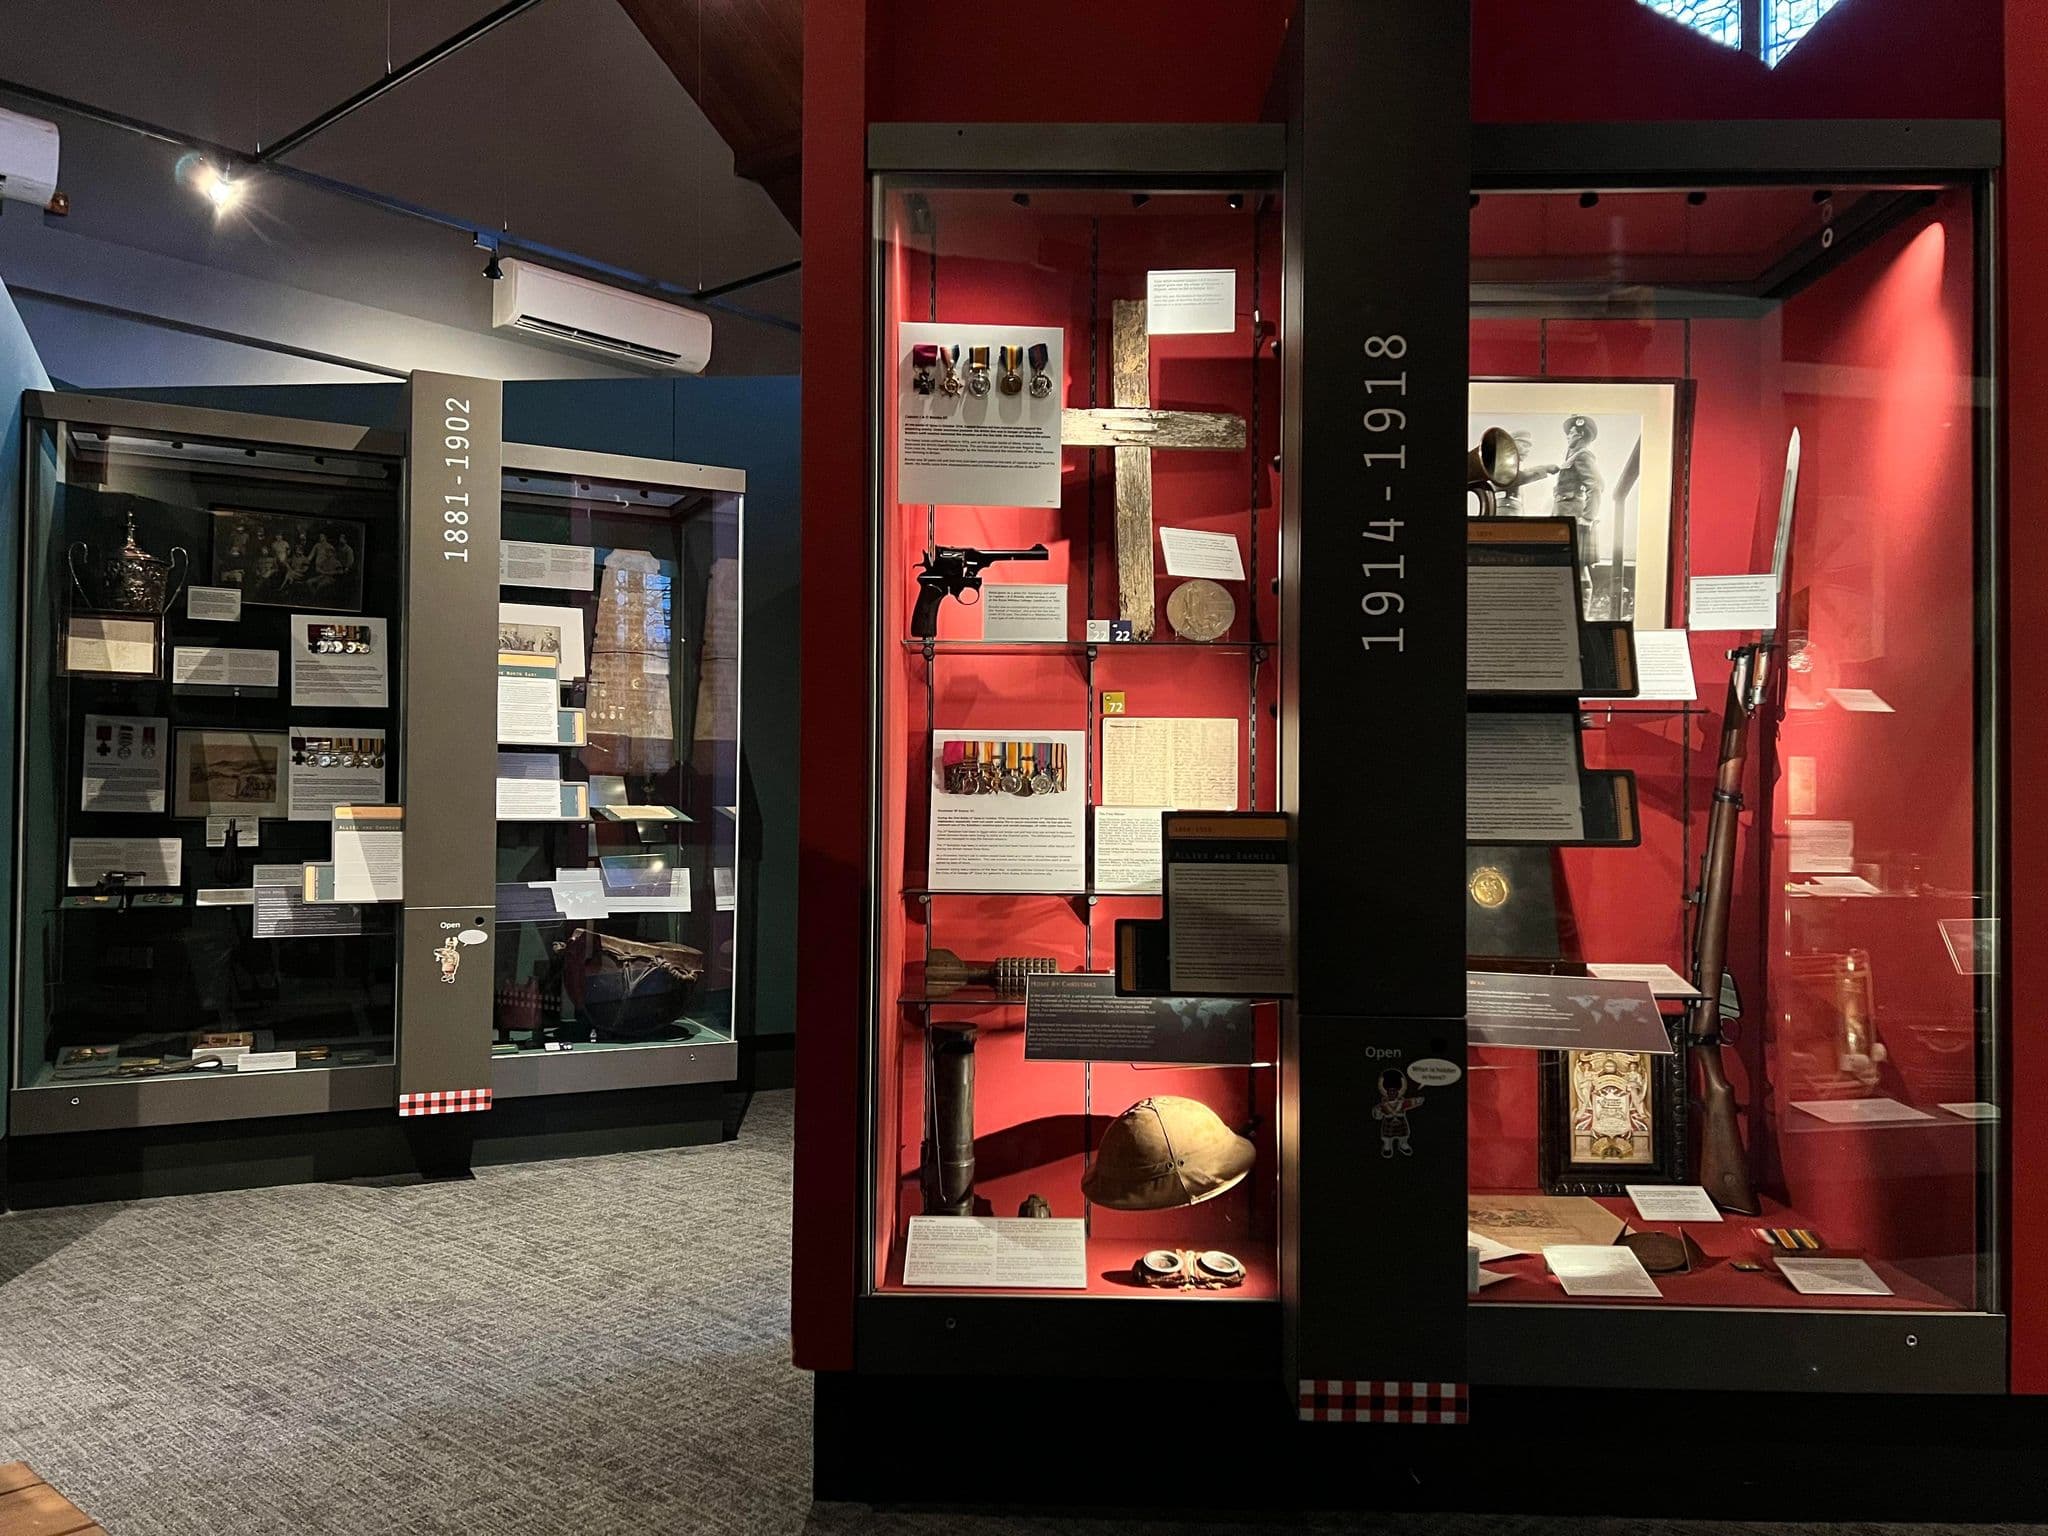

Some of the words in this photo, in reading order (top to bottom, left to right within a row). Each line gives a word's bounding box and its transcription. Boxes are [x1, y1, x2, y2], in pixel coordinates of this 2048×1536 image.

[444, 398, 470, 563] 1881-1902
[1361, 334, 1407, 653] 1914-1918
[1115, 630, 1130, 642] 22
[1109, 703, 1123, 713] 72
[440, 921, 461, 929] Open
[1365, 1046, 1402, 1060] Open
